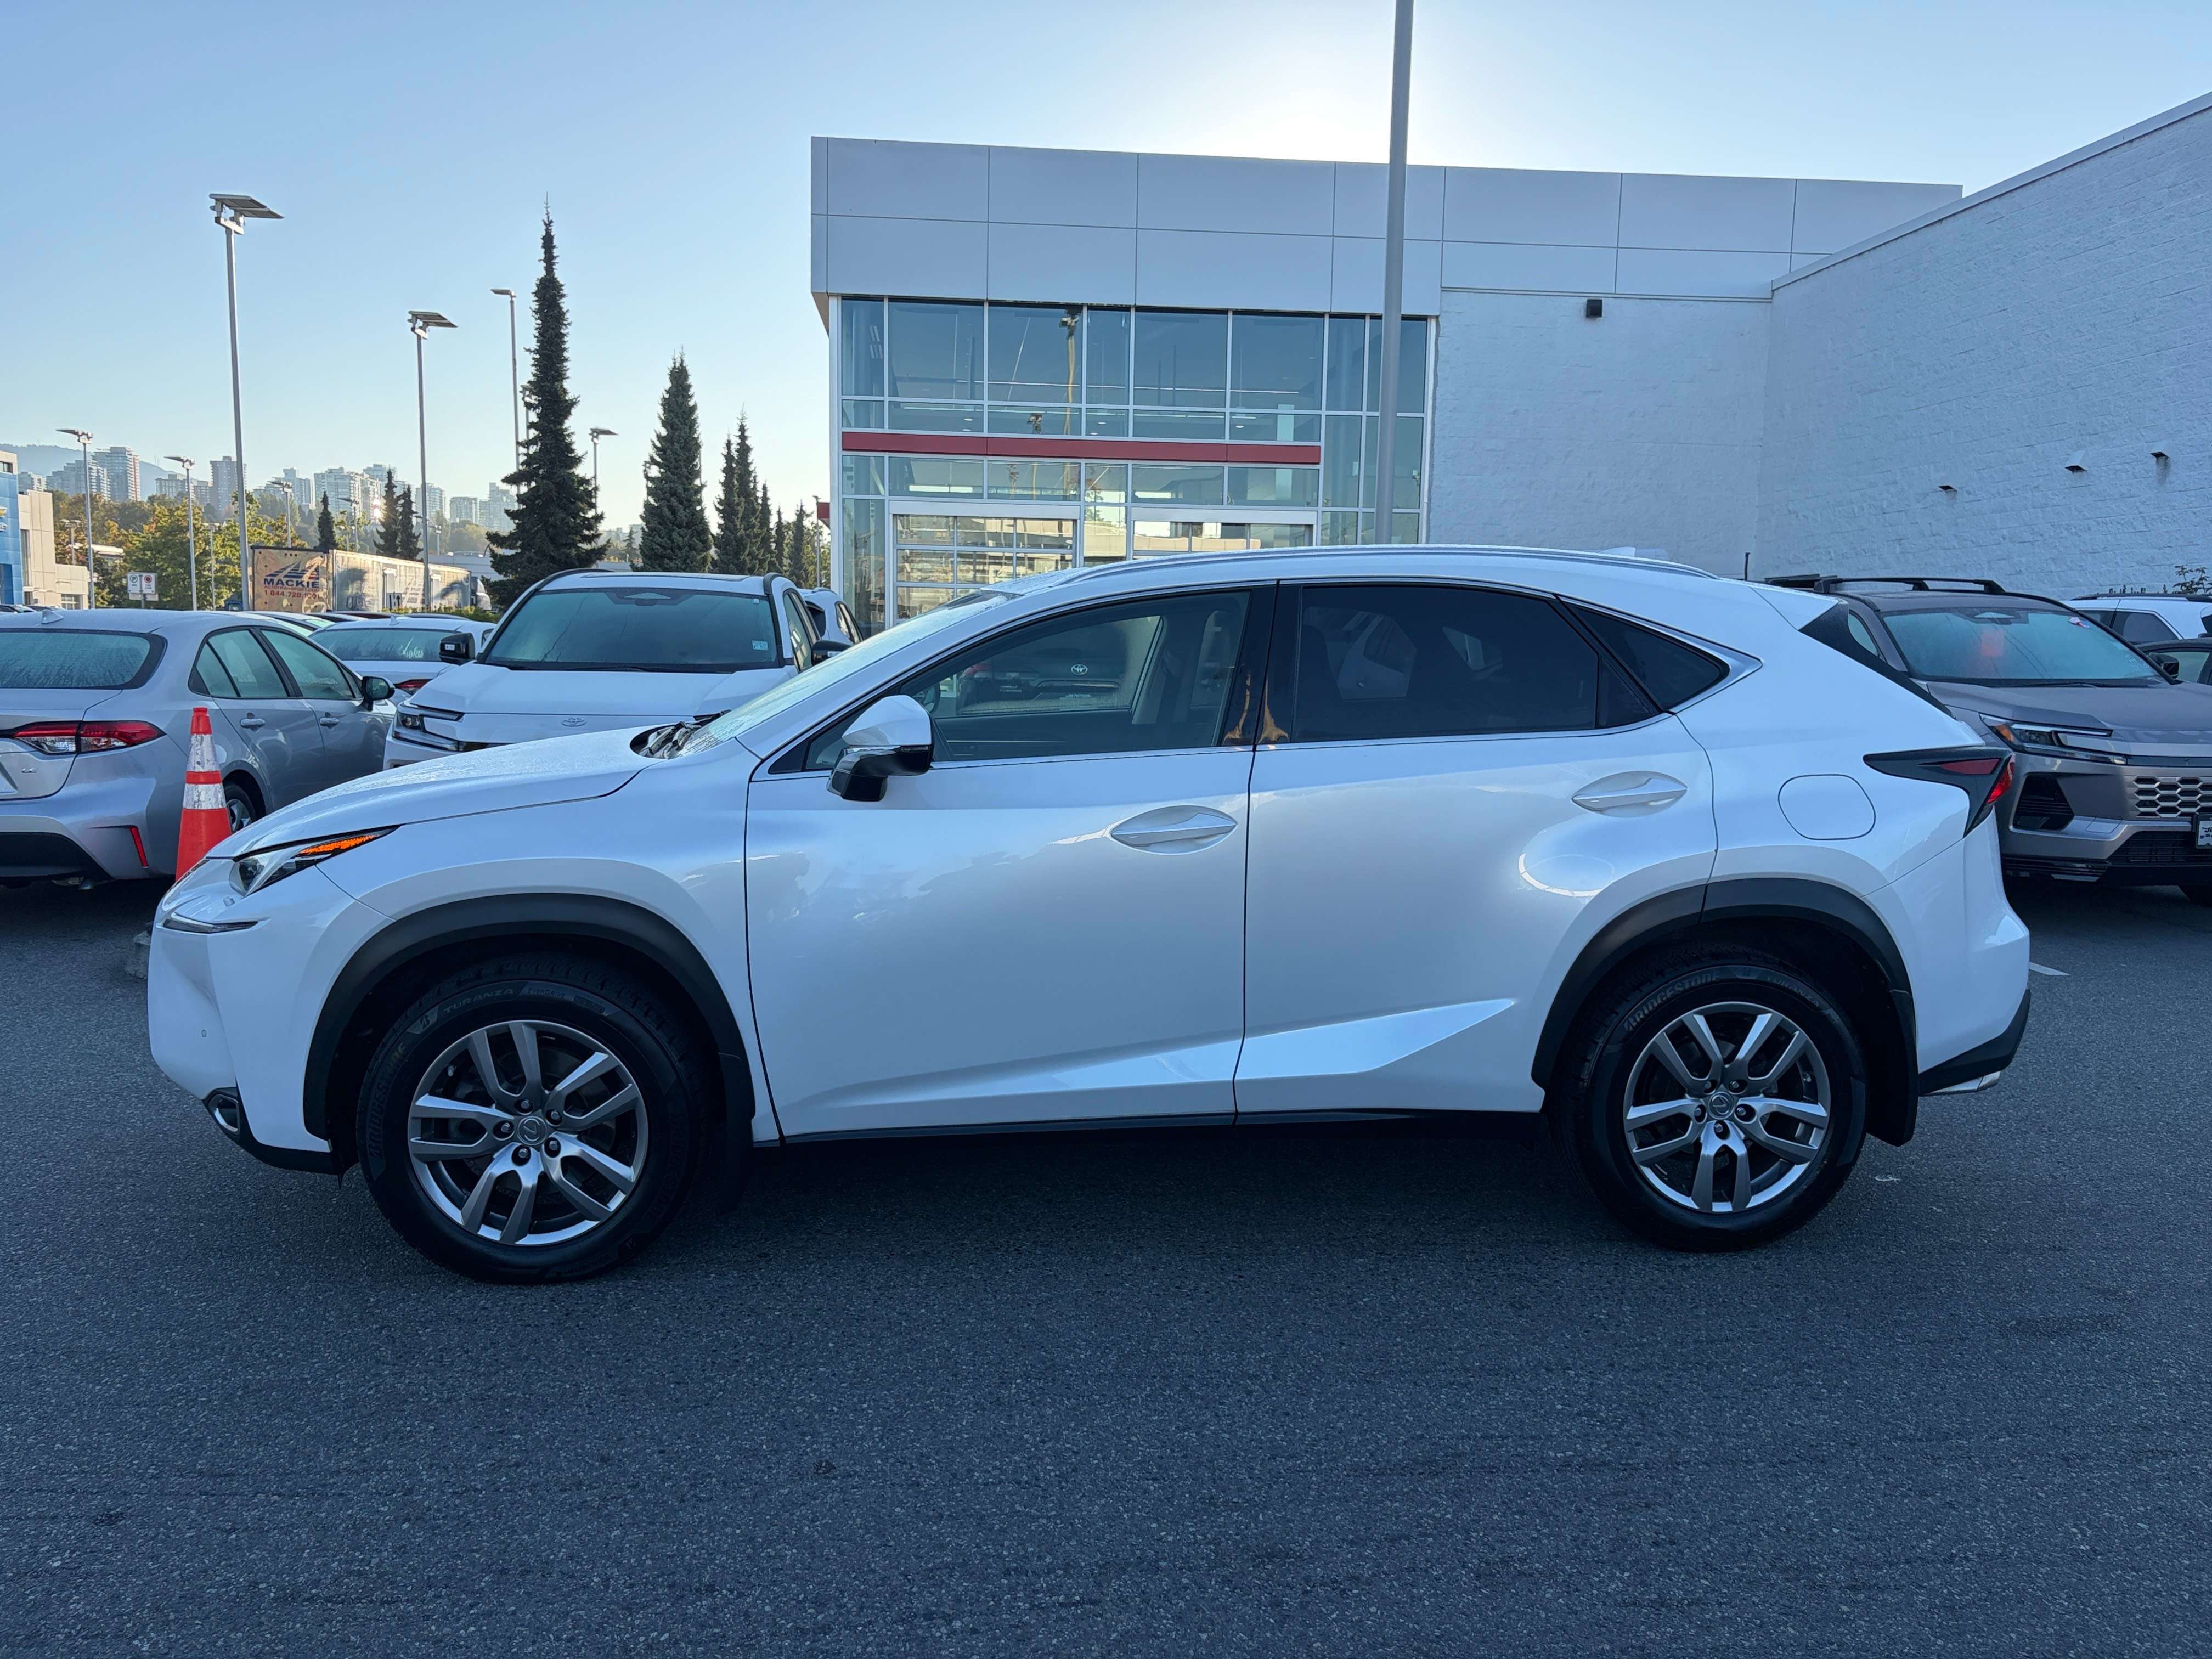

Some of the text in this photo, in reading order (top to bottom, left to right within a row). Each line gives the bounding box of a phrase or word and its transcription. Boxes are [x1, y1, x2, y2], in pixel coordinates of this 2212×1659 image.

[263, 578, 320, 589] MACKIE
[443, 988, 515, 1014] TURANZA
[1623, 972, 1721, 1033] BRIDGESTONE
[1765, 974, 1820, 1007] TURANZA
